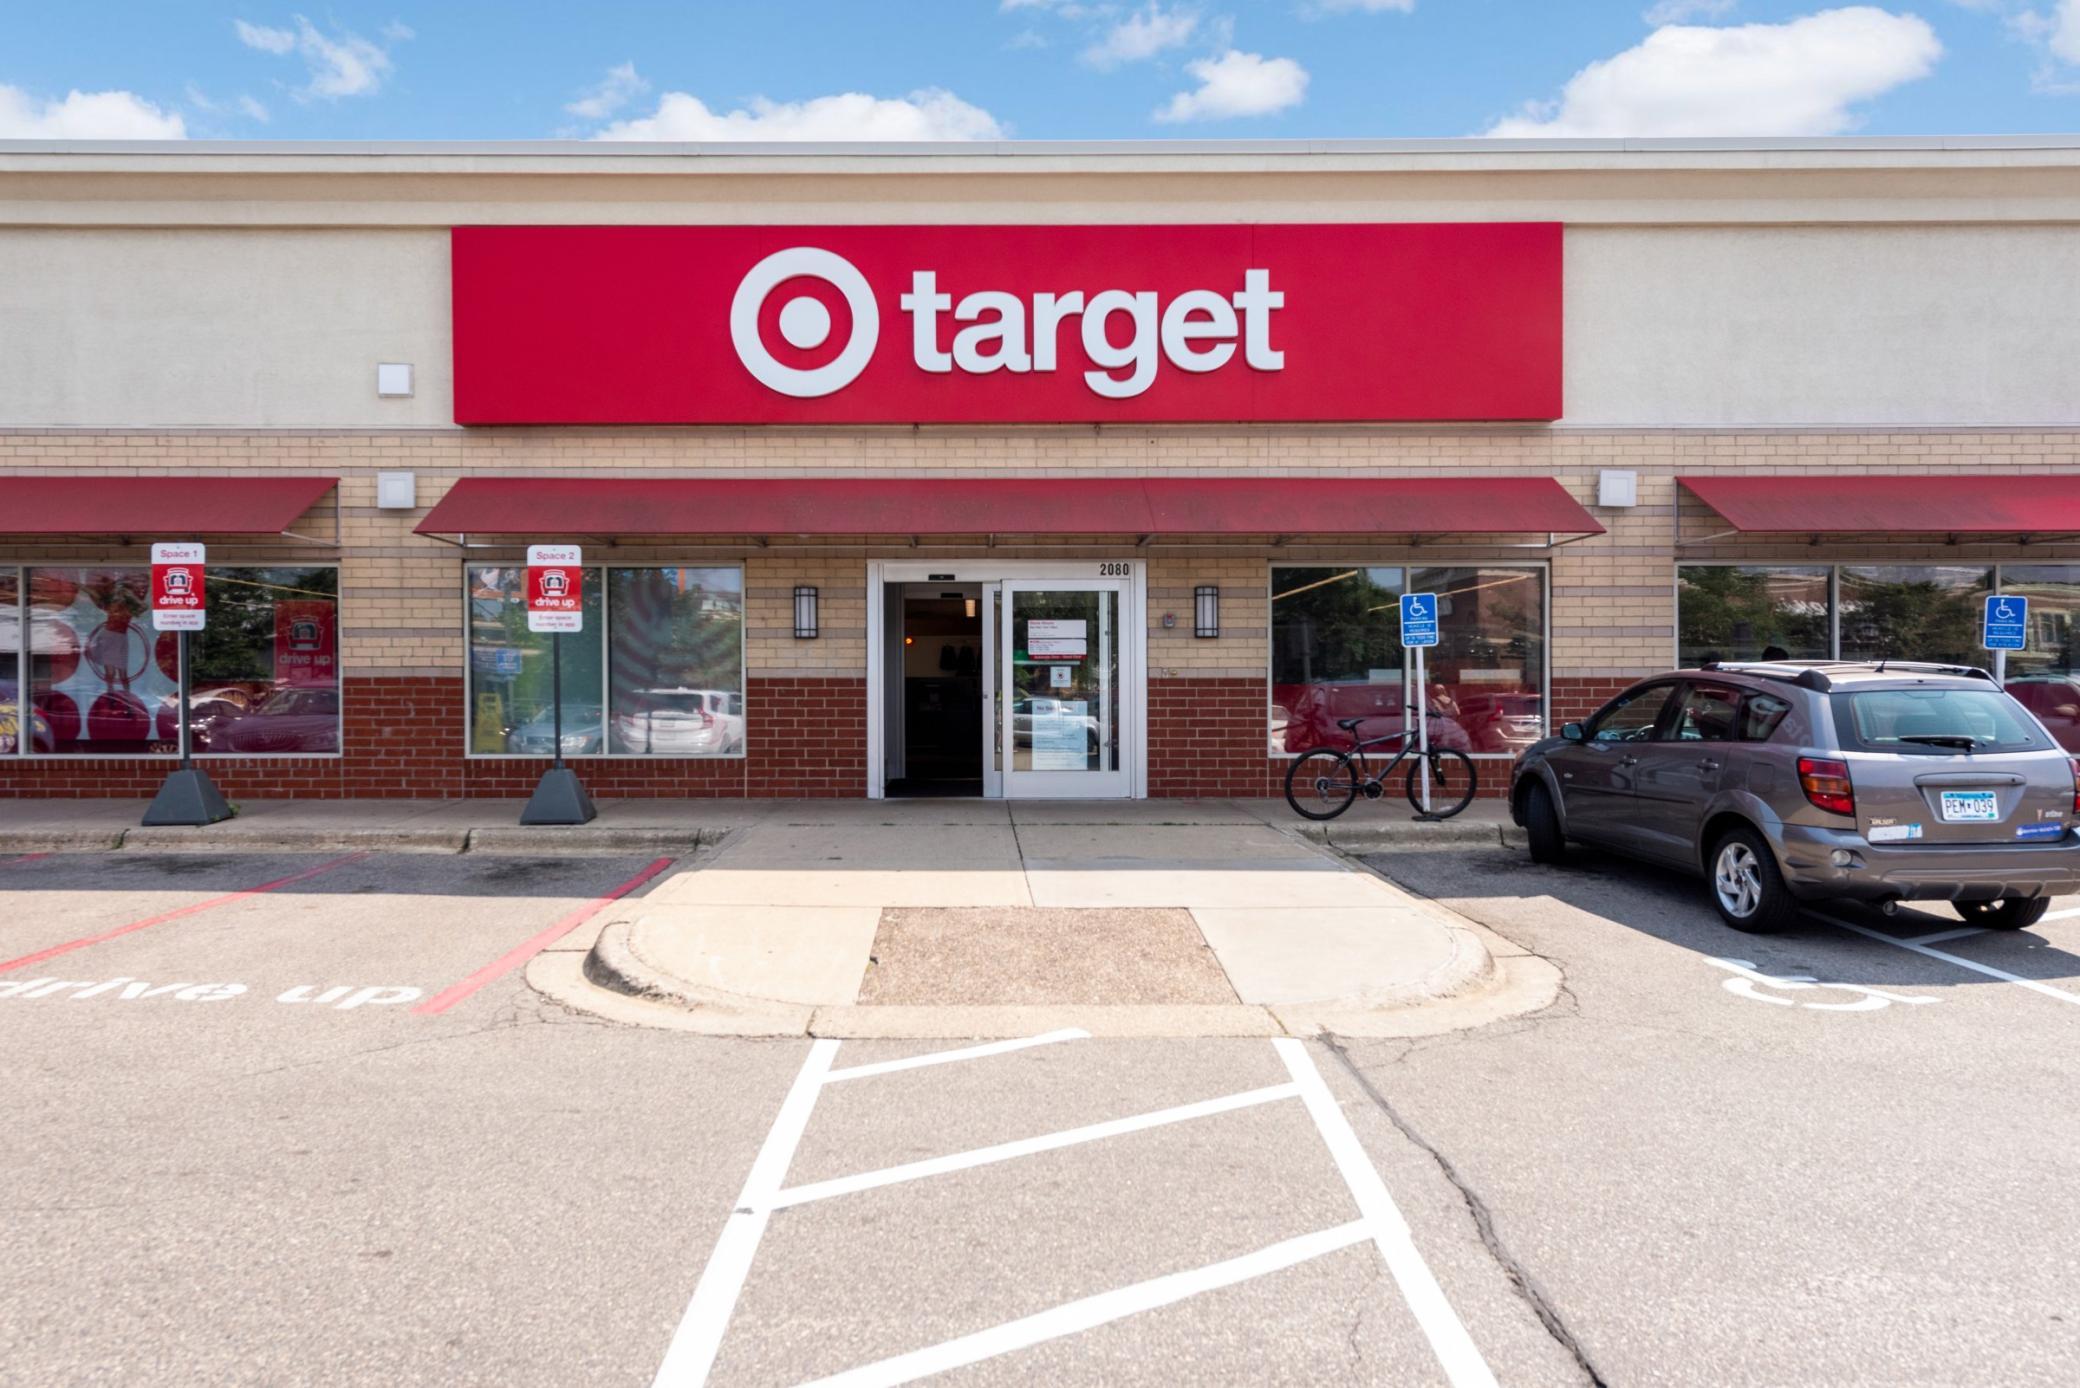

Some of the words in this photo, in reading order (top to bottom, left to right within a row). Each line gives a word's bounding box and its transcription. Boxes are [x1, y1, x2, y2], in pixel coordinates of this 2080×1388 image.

[901, 268, 1284, 398] target
[160, 549, 190, 559] Space
[536, 551, 566, 561] Space
[568, 552, 575, 560] 2
[1100, 563, 1129, 576] 2080
[159, 595, 184, 605] drive
[185, 597, 199, 606] up
[534, 597, 560, 607] drive
[561, 599, 575, 608] up
[280, 652, 311, 664] drive
[314, 655, 331, 666] up
[1945, 799, 1967, 813] PEM
[1973, 799, 1994, 813] 039
[0, 977, 249, 1001] drive
[276, 984, 423, 1009] up
